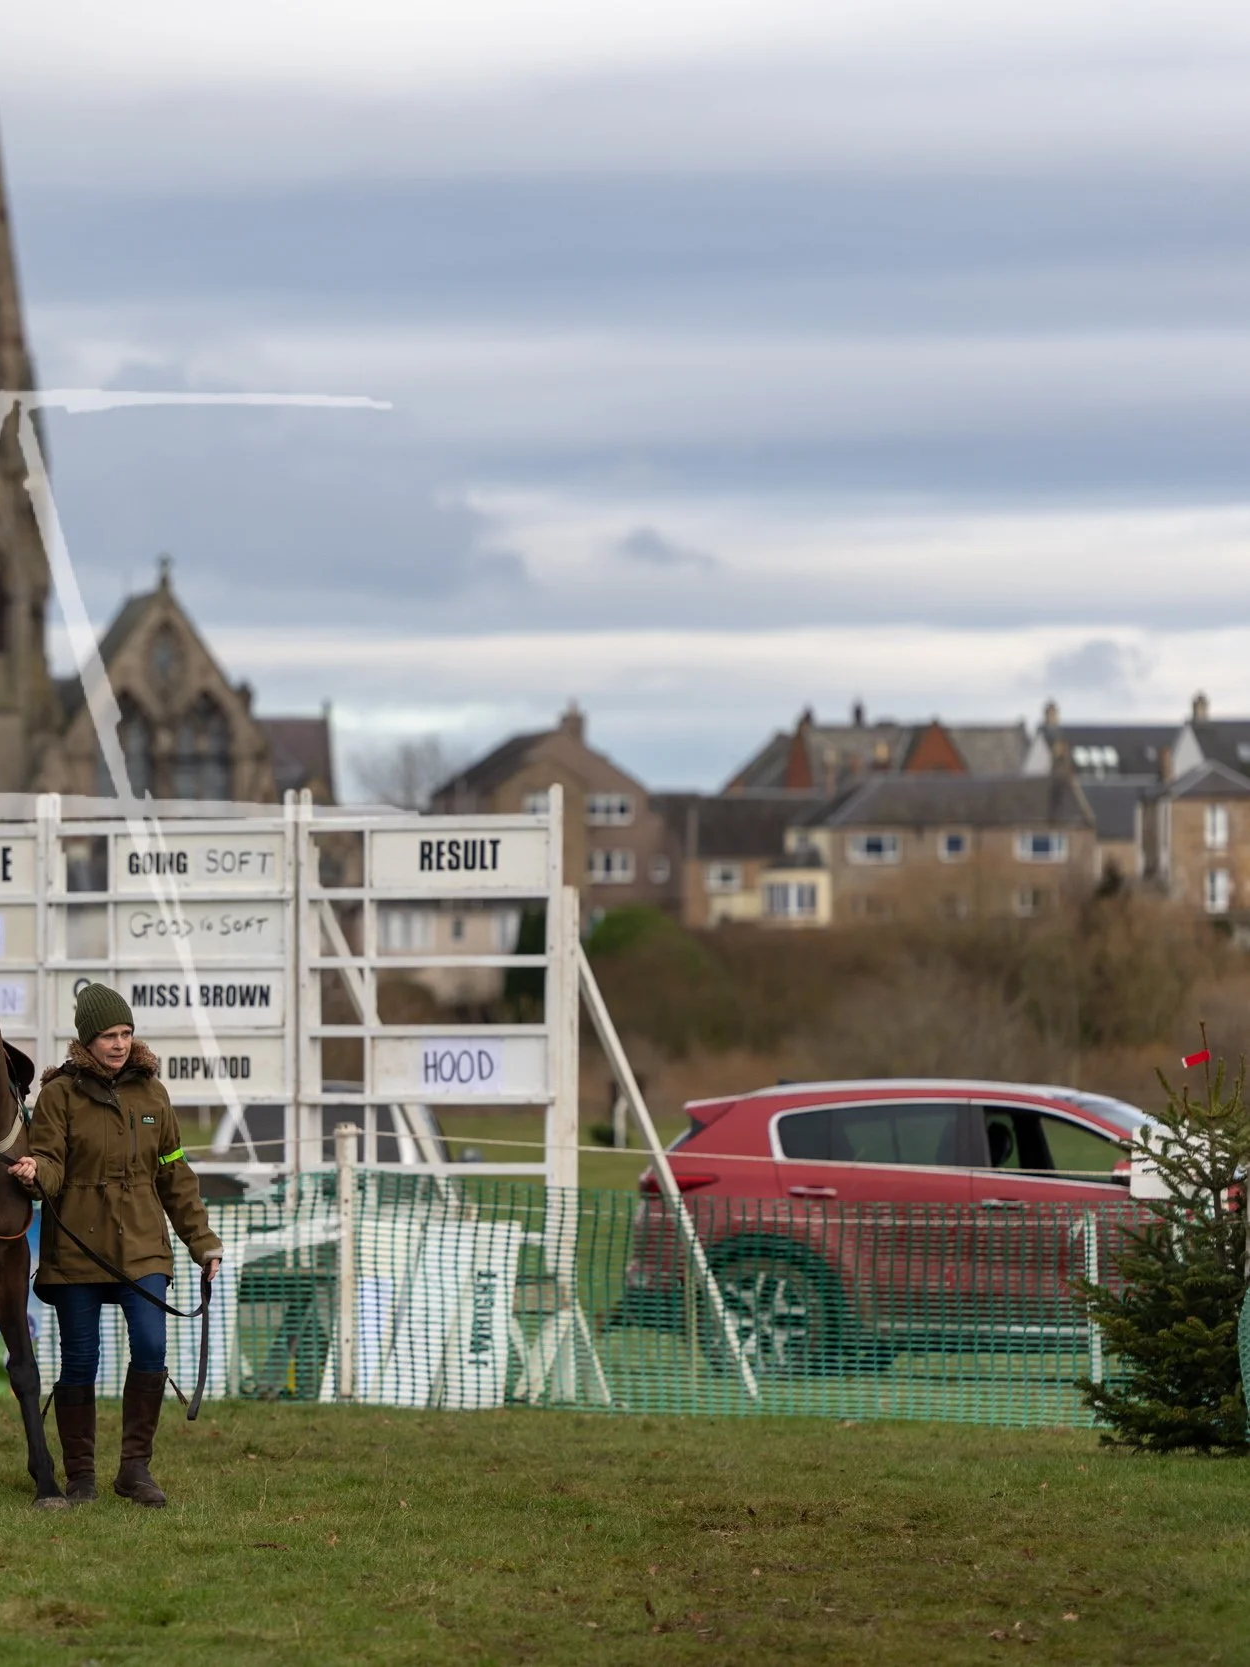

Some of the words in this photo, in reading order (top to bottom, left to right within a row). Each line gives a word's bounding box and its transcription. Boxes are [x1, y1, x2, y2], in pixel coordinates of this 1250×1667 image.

[128, 852, 187, 875] GOING
[206, 849, 274, 874] SOFT
[419, 839, 501, 872] RESULT
[132, 984, 180, 1007] MISS
[200, 984, 270, 1007] BROWN
[168, 1056, 250, 1079] ORPWOOD
[423, 1050, 494, 1083] HOOD
